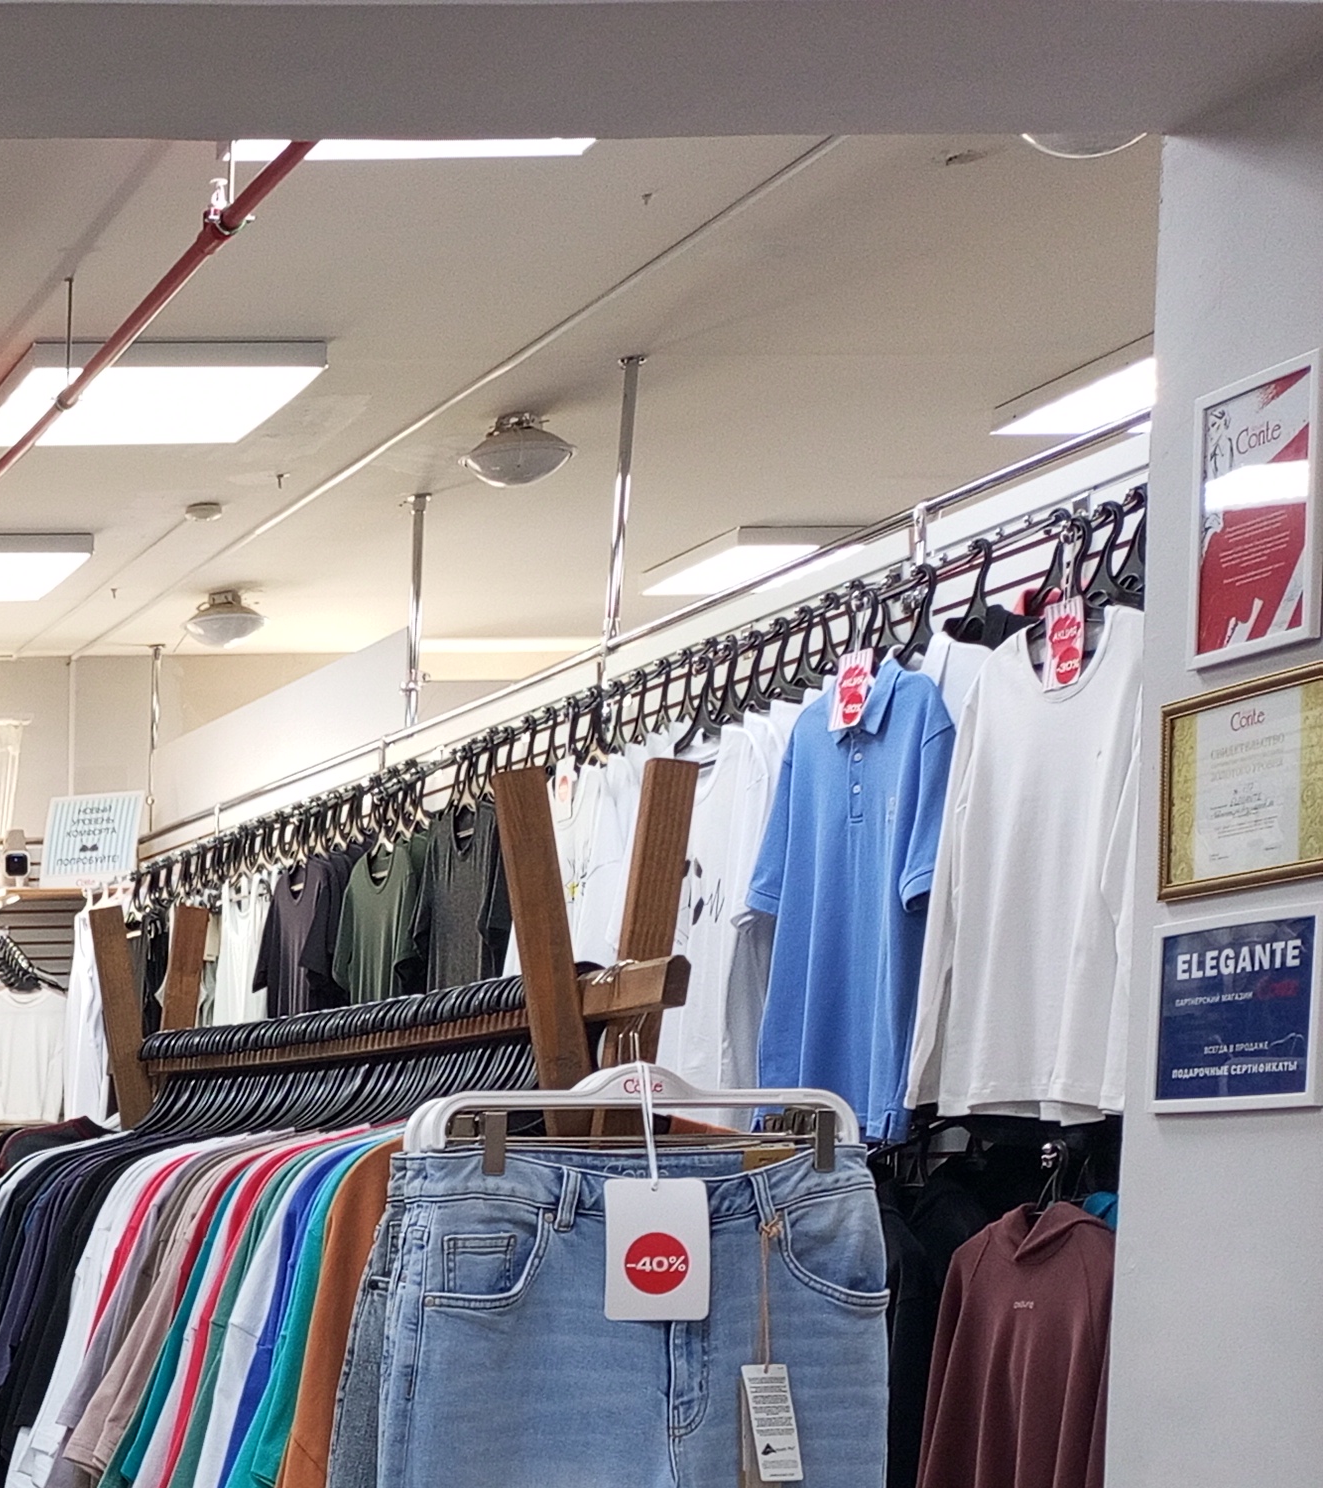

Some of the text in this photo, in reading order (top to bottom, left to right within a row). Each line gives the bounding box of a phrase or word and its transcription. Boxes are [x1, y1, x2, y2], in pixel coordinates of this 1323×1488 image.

[1236, 421, 1281, 454] Conte
[1230, 709, 1265, 732] Conte
[1176, 939, 1302, 980] ELEGANTE
[1204, 1043, 1228, 1054] ВСЕГДА
[1235, 1041, 1269, 1052] ПРОДАЖЕ
[1171, 1061, 1298, 1079] ПОДАРОЧНЫЕ СЕРТИФИКАТЫ
[626, 1255, 686, 1273] -40%
